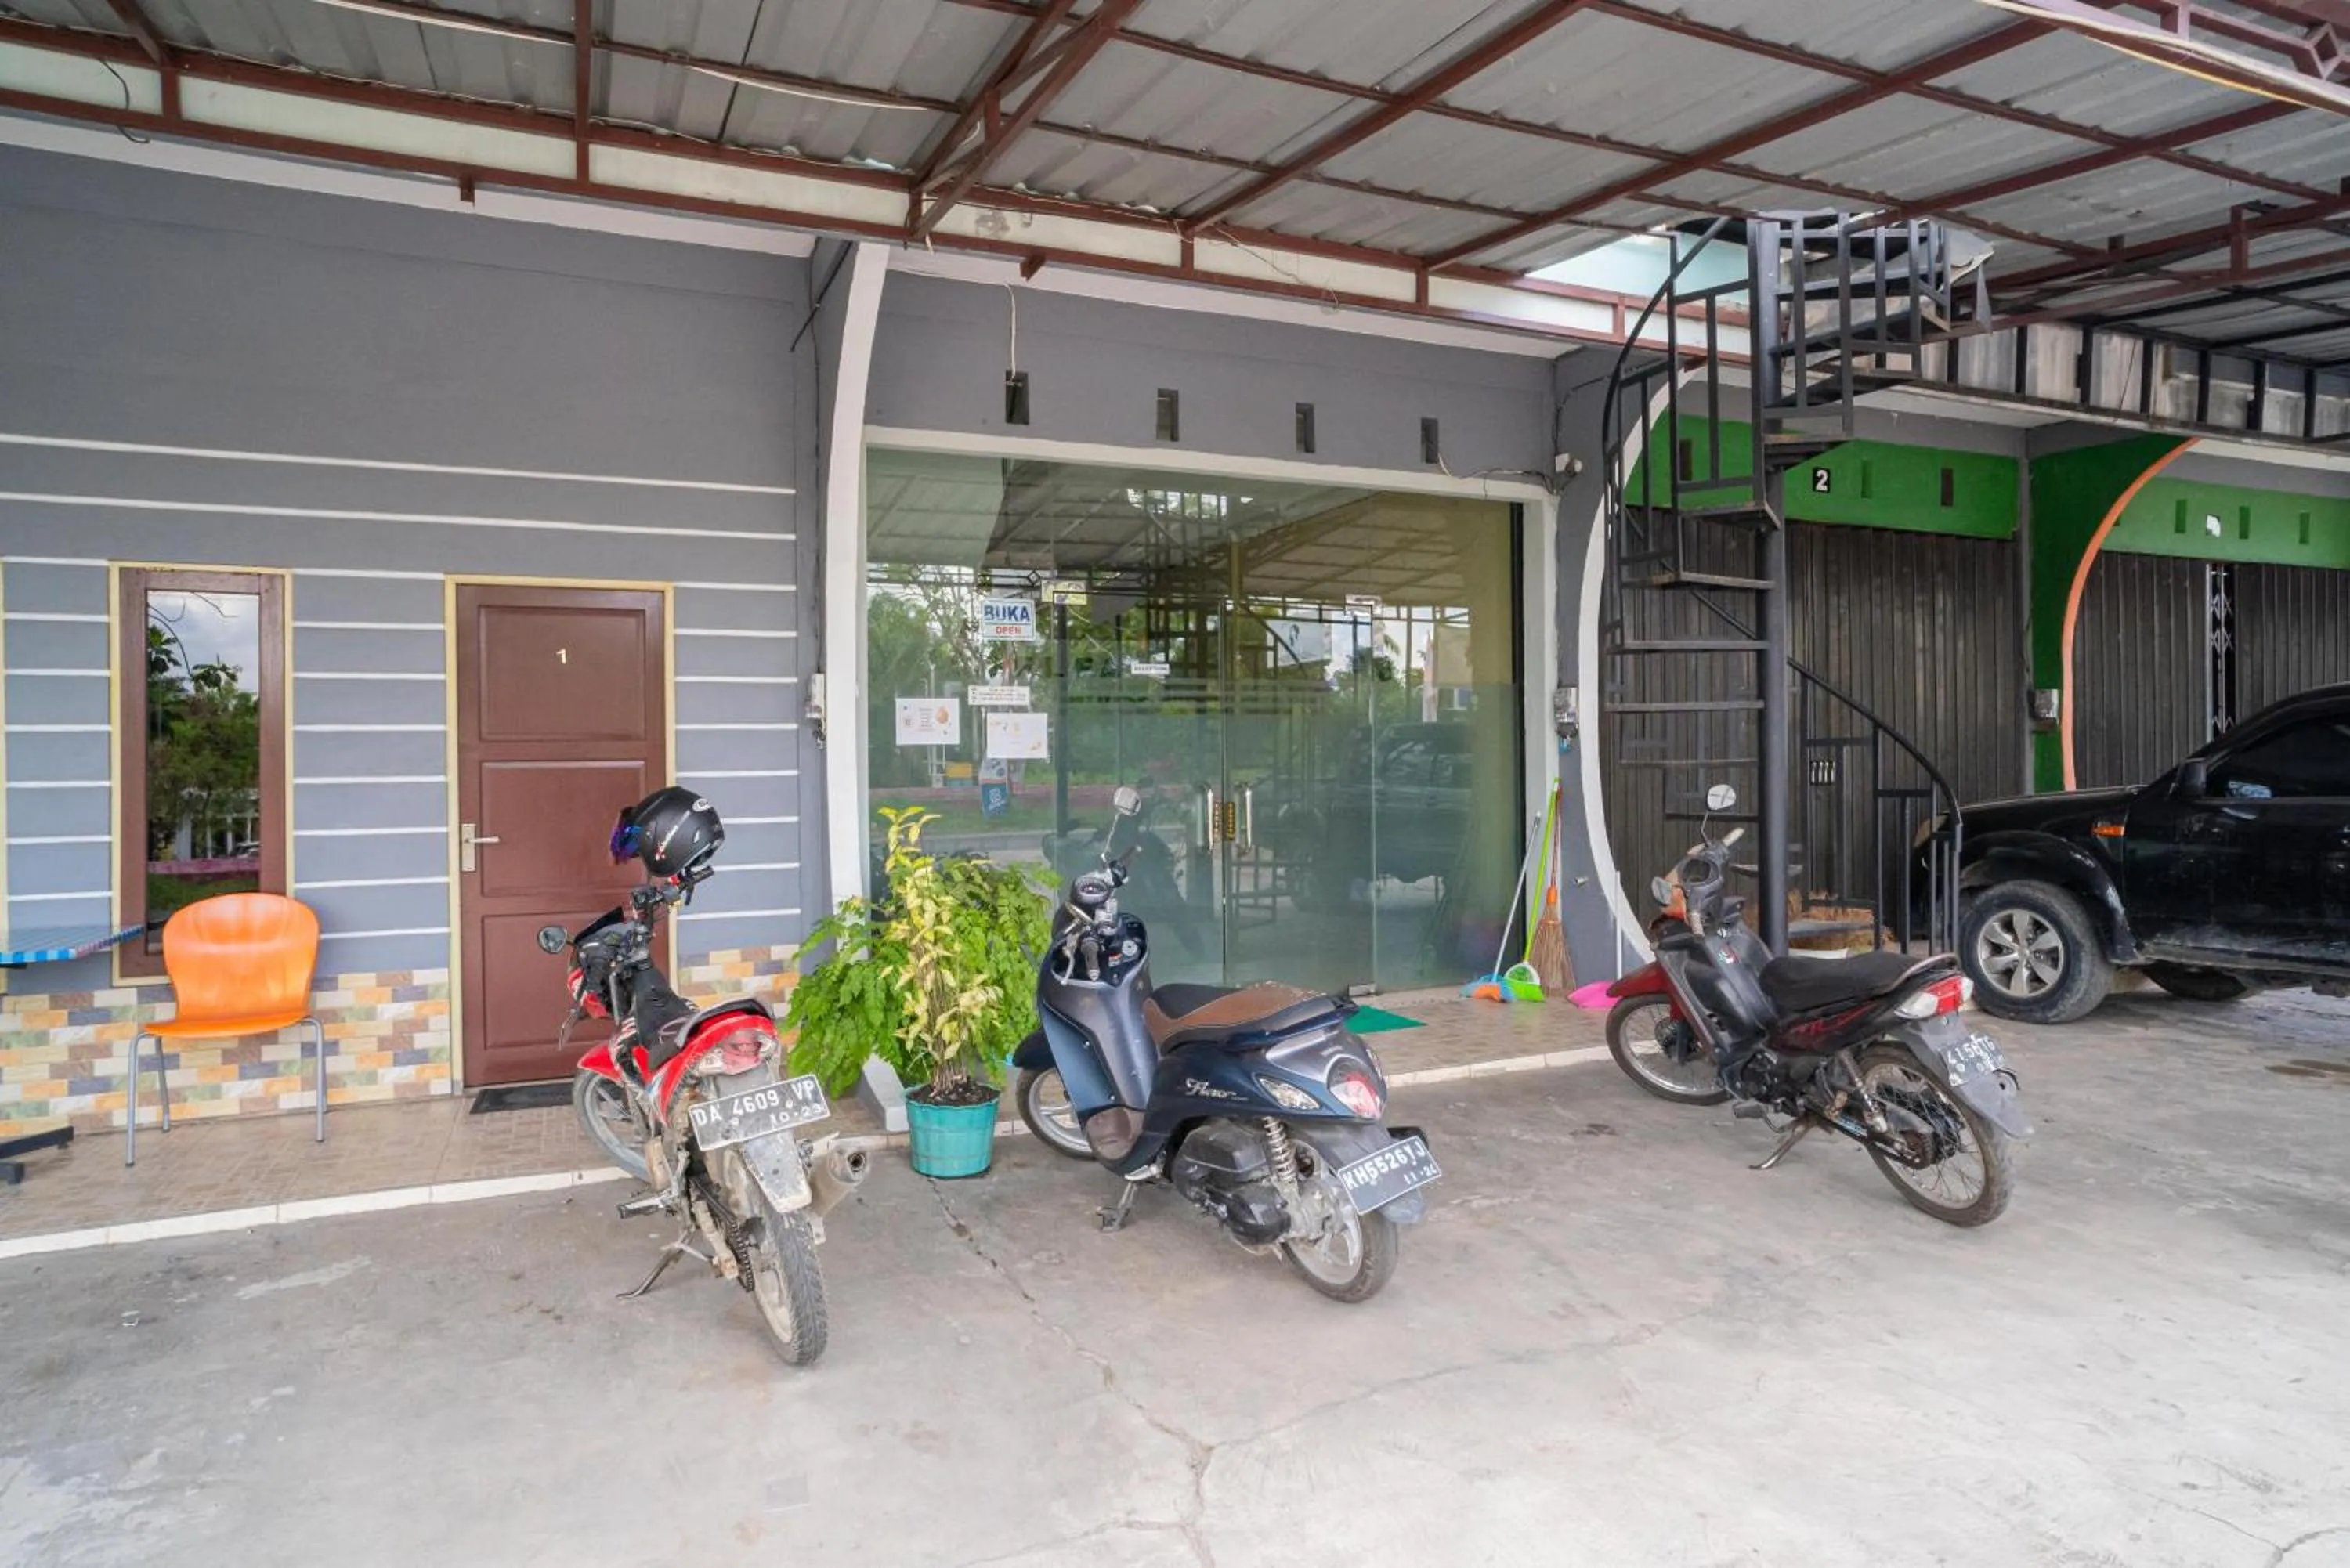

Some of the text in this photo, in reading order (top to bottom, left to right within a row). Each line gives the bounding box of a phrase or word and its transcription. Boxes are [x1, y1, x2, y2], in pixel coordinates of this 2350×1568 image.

[1816, 469, 1828, 491] 2
[983, 605, 1030, 622] BUKA
[995, 626, 1022, 635] OPEN
[556, 648, 566, 665] 1
[694, 1080, 815, 1126] DA 4609 VP
